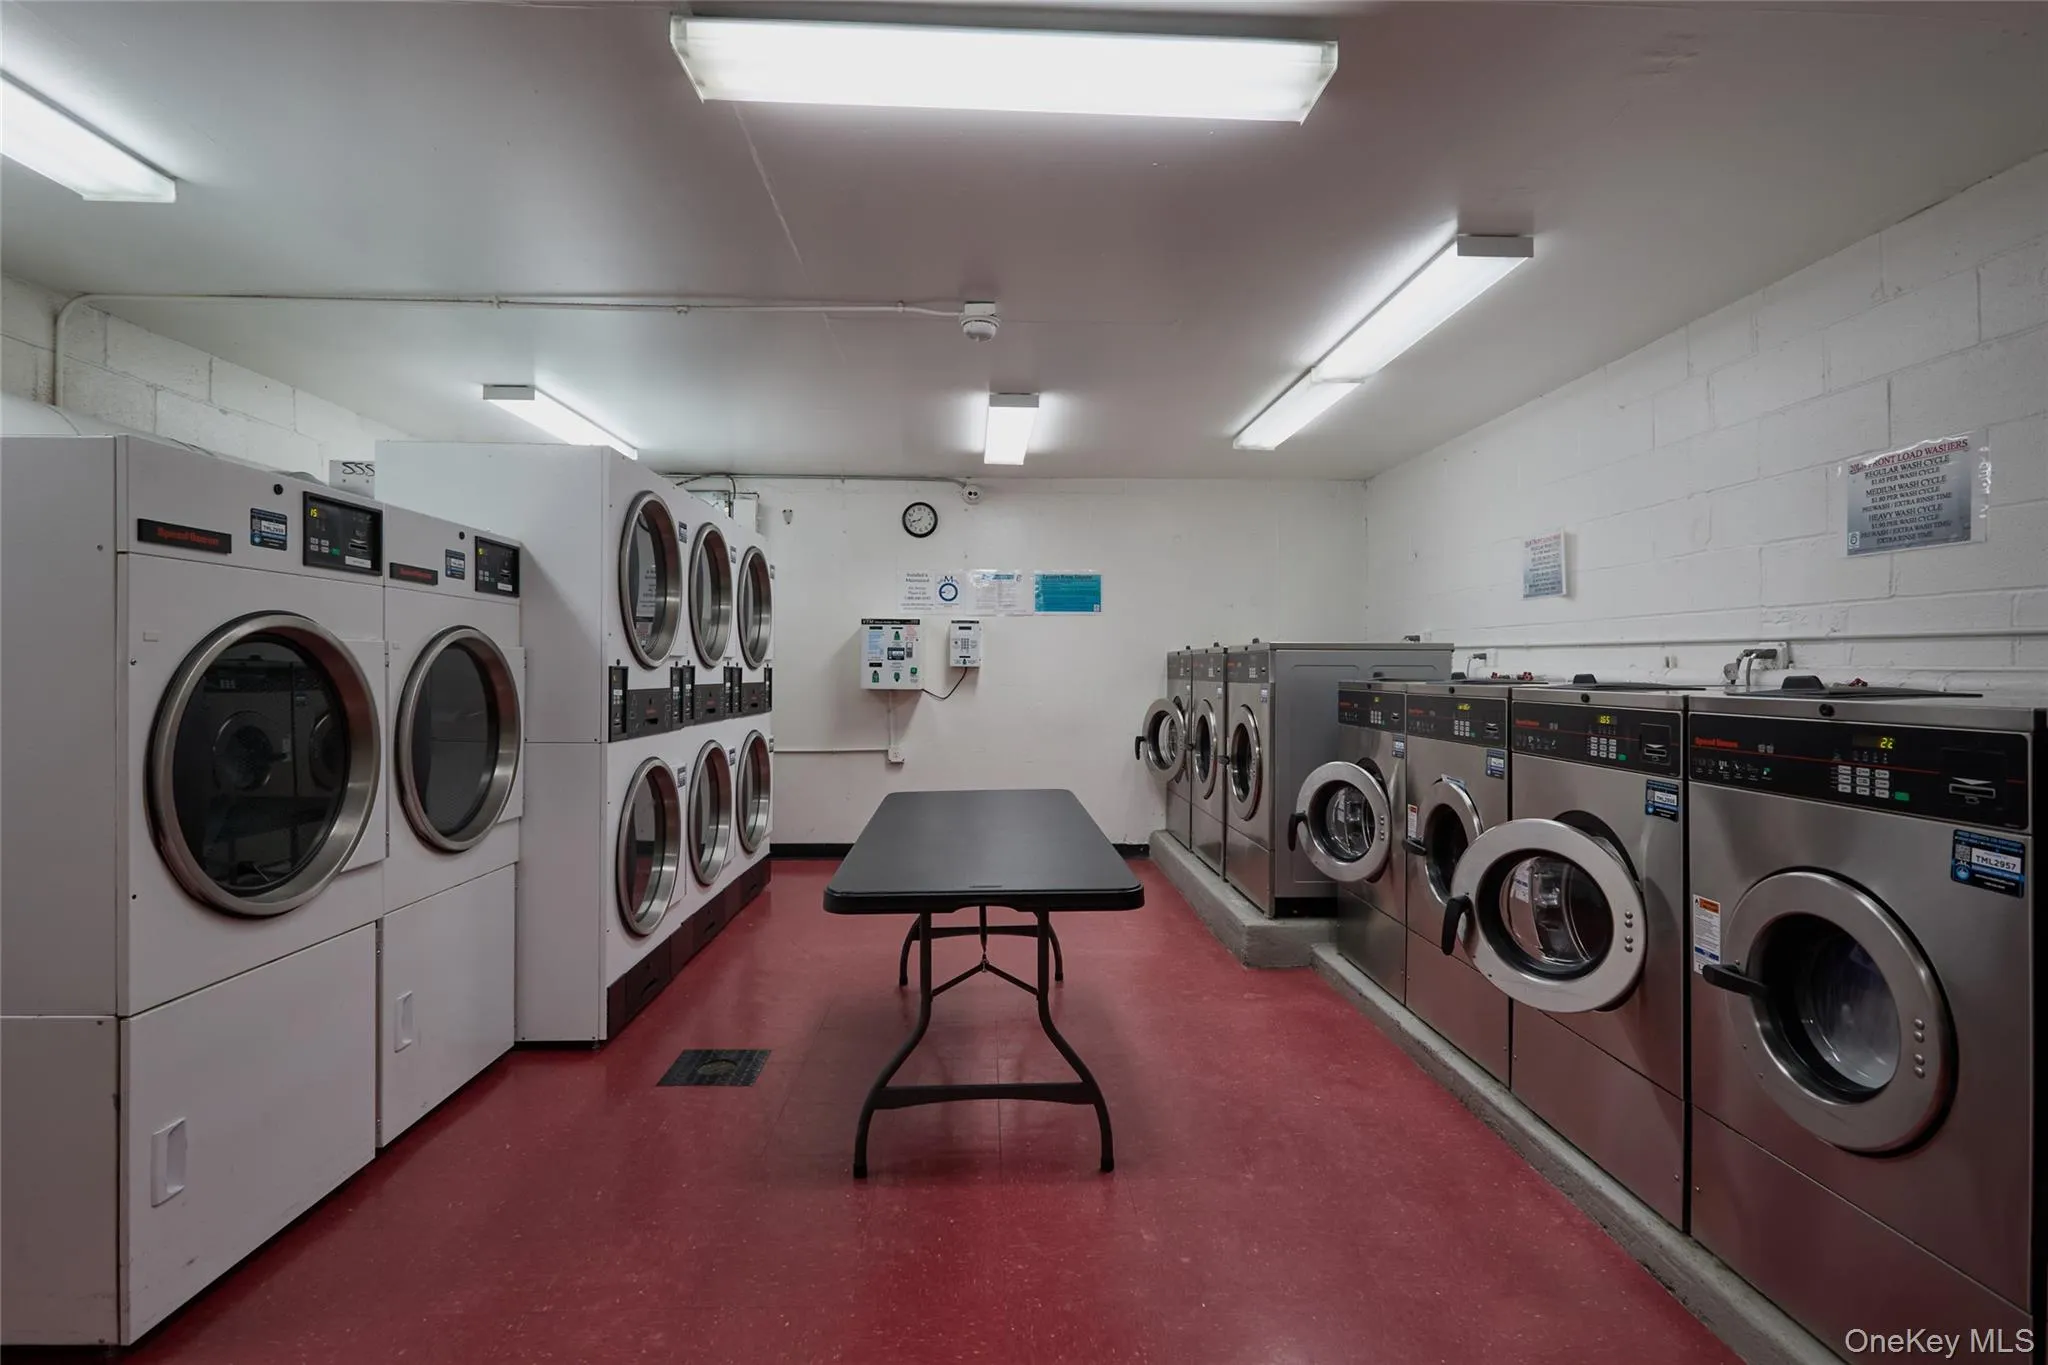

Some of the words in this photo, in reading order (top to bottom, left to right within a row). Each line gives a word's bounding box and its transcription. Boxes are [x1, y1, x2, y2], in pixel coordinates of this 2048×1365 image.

[1897, 450, 1922, 462] LOAD
[1924, 439, 1968, 455] WASHERS
[1864, 465, 1898, 479] REGULAR
[1900, 460, 1922, 471] WASH
[1923, 455, 1950, 467] CYCLE
[1899, 470, 1918, 480] WASH
[1918, 466, 1940, 476] CYCLE
[1865, 484, 1897, 498] MEDIUM
[1897, 480, 1919, 490] WASH
[1920, 474, 1947, 487] CYCLE
[1886, 493, 1899, 501] PER
[1899, 489, 1918, 498] WASH
[1918, 485, 1940, 495] CYCLE
[1895, 499, 1915, 508] EXTRA
[1936, 492, 1952, 501] TIME
[1868, 511, 1892, 523] HEAVY
[1894, 507, 1915, 517] WASH
[1917, 502, 1943, 514] CYCLE
[1899, 516, 1917, 525] WASH
[1917, 512, 1939, 522] CYCLE
[1975, 855, 2016, 871] TML2957
